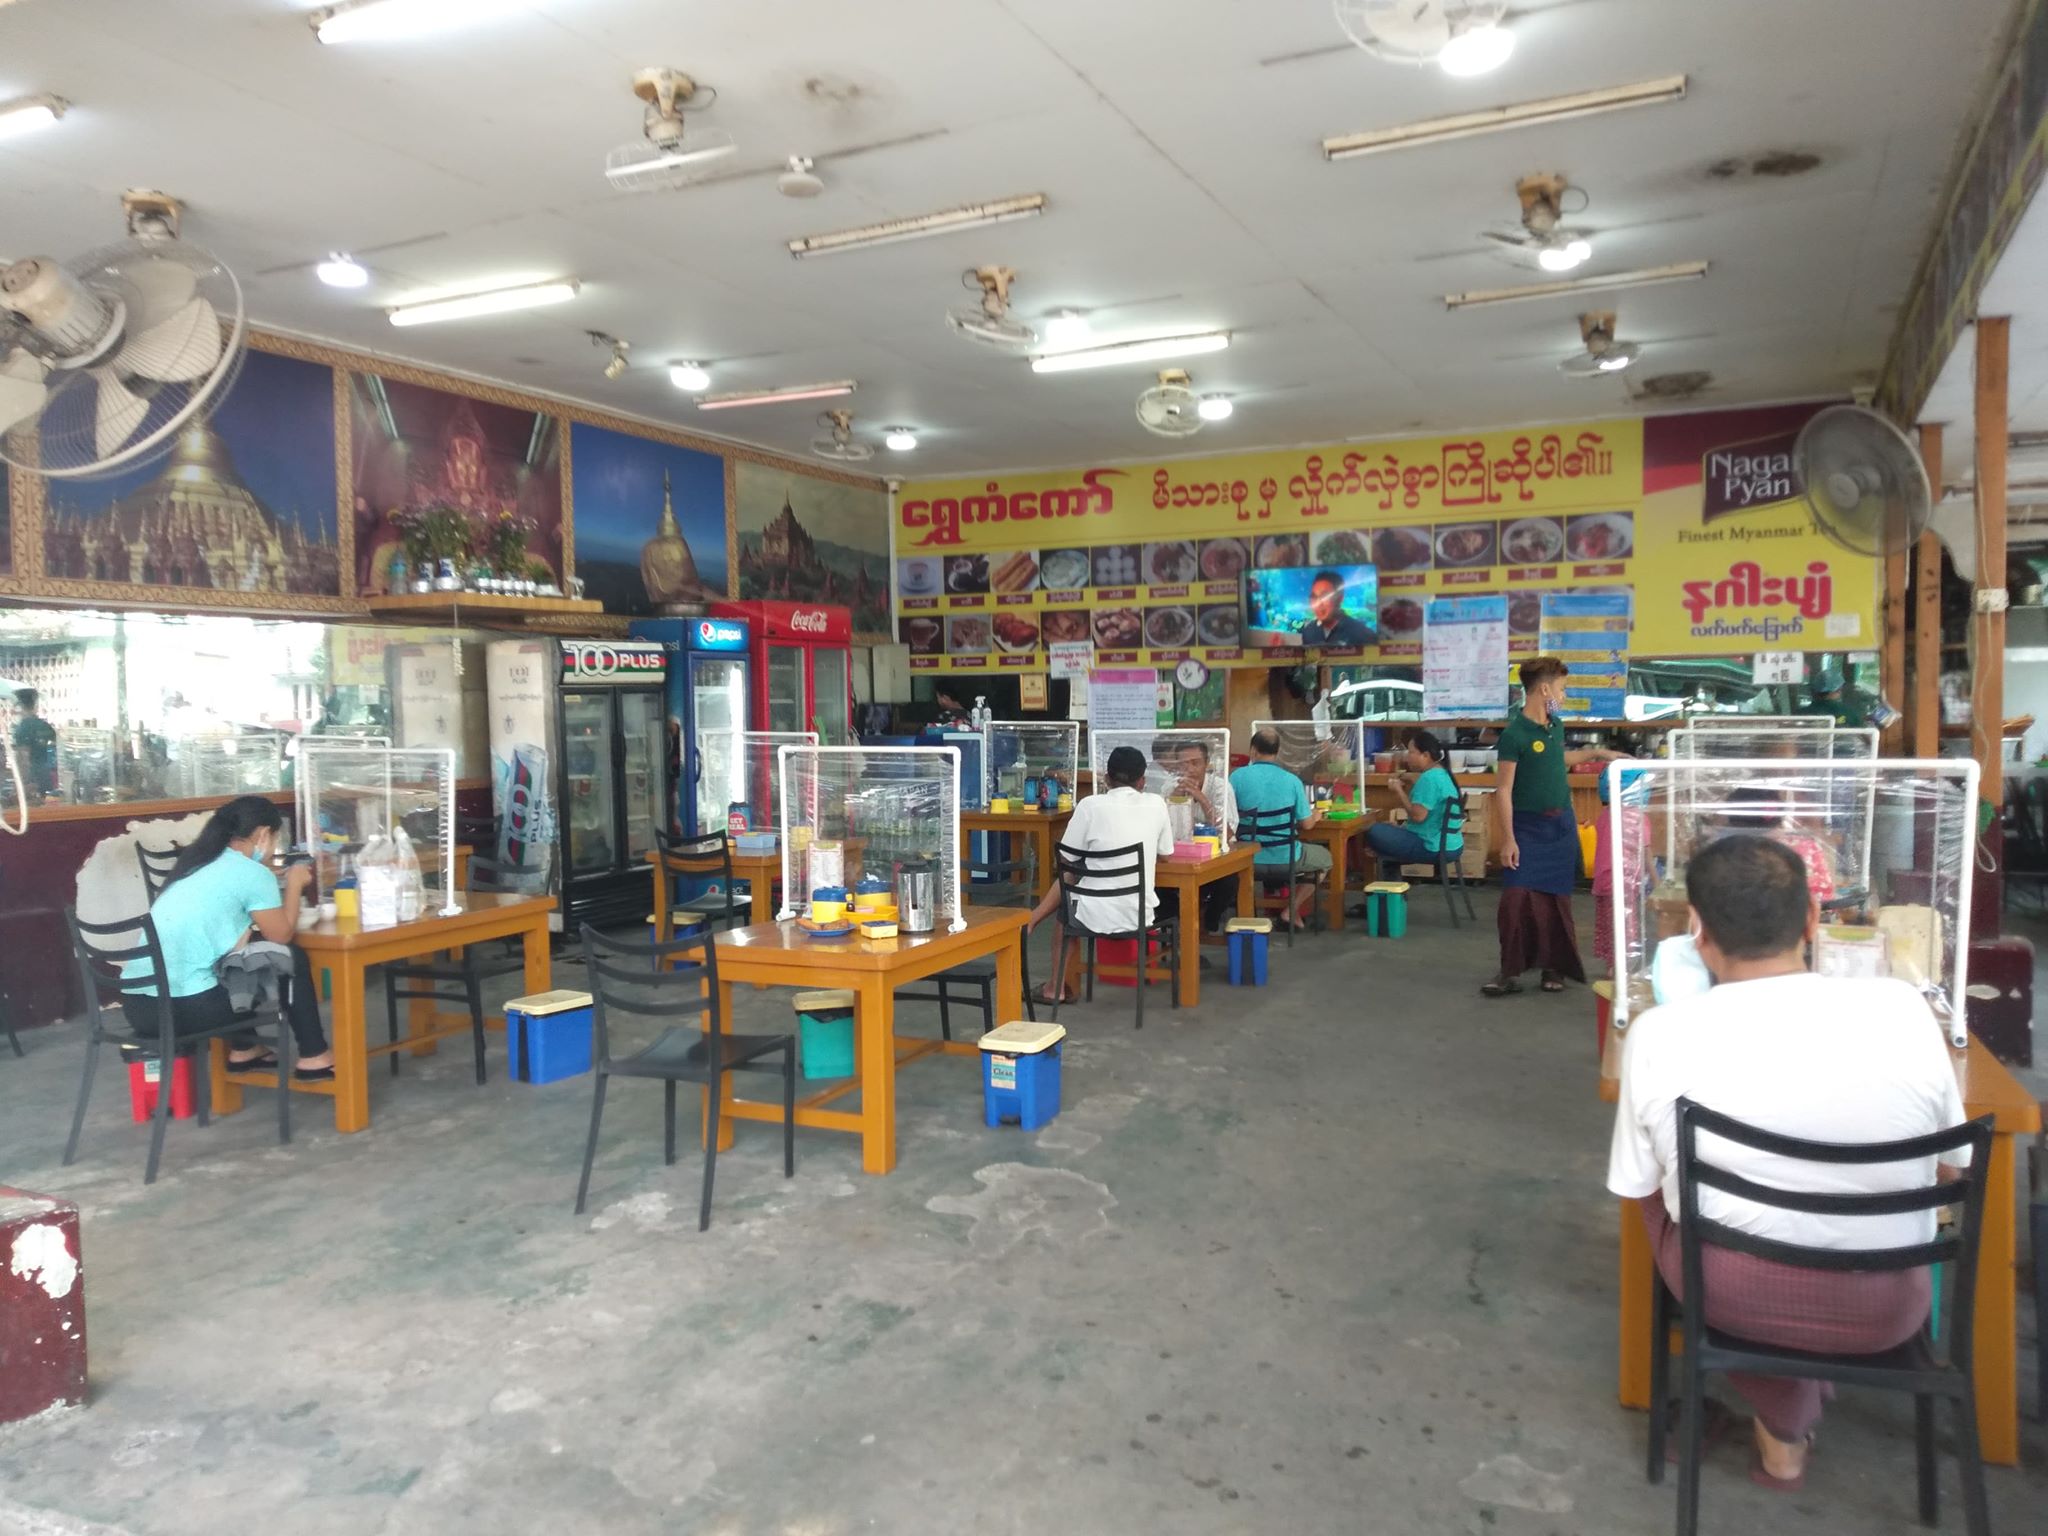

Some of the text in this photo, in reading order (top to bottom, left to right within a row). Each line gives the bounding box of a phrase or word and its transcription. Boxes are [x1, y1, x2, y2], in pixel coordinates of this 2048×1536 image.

[1725, 478, 1791, 504] Pyan
[1678, 529, 1723, 543] Finest
[1730, 526, 1805, 543] Myanmar
